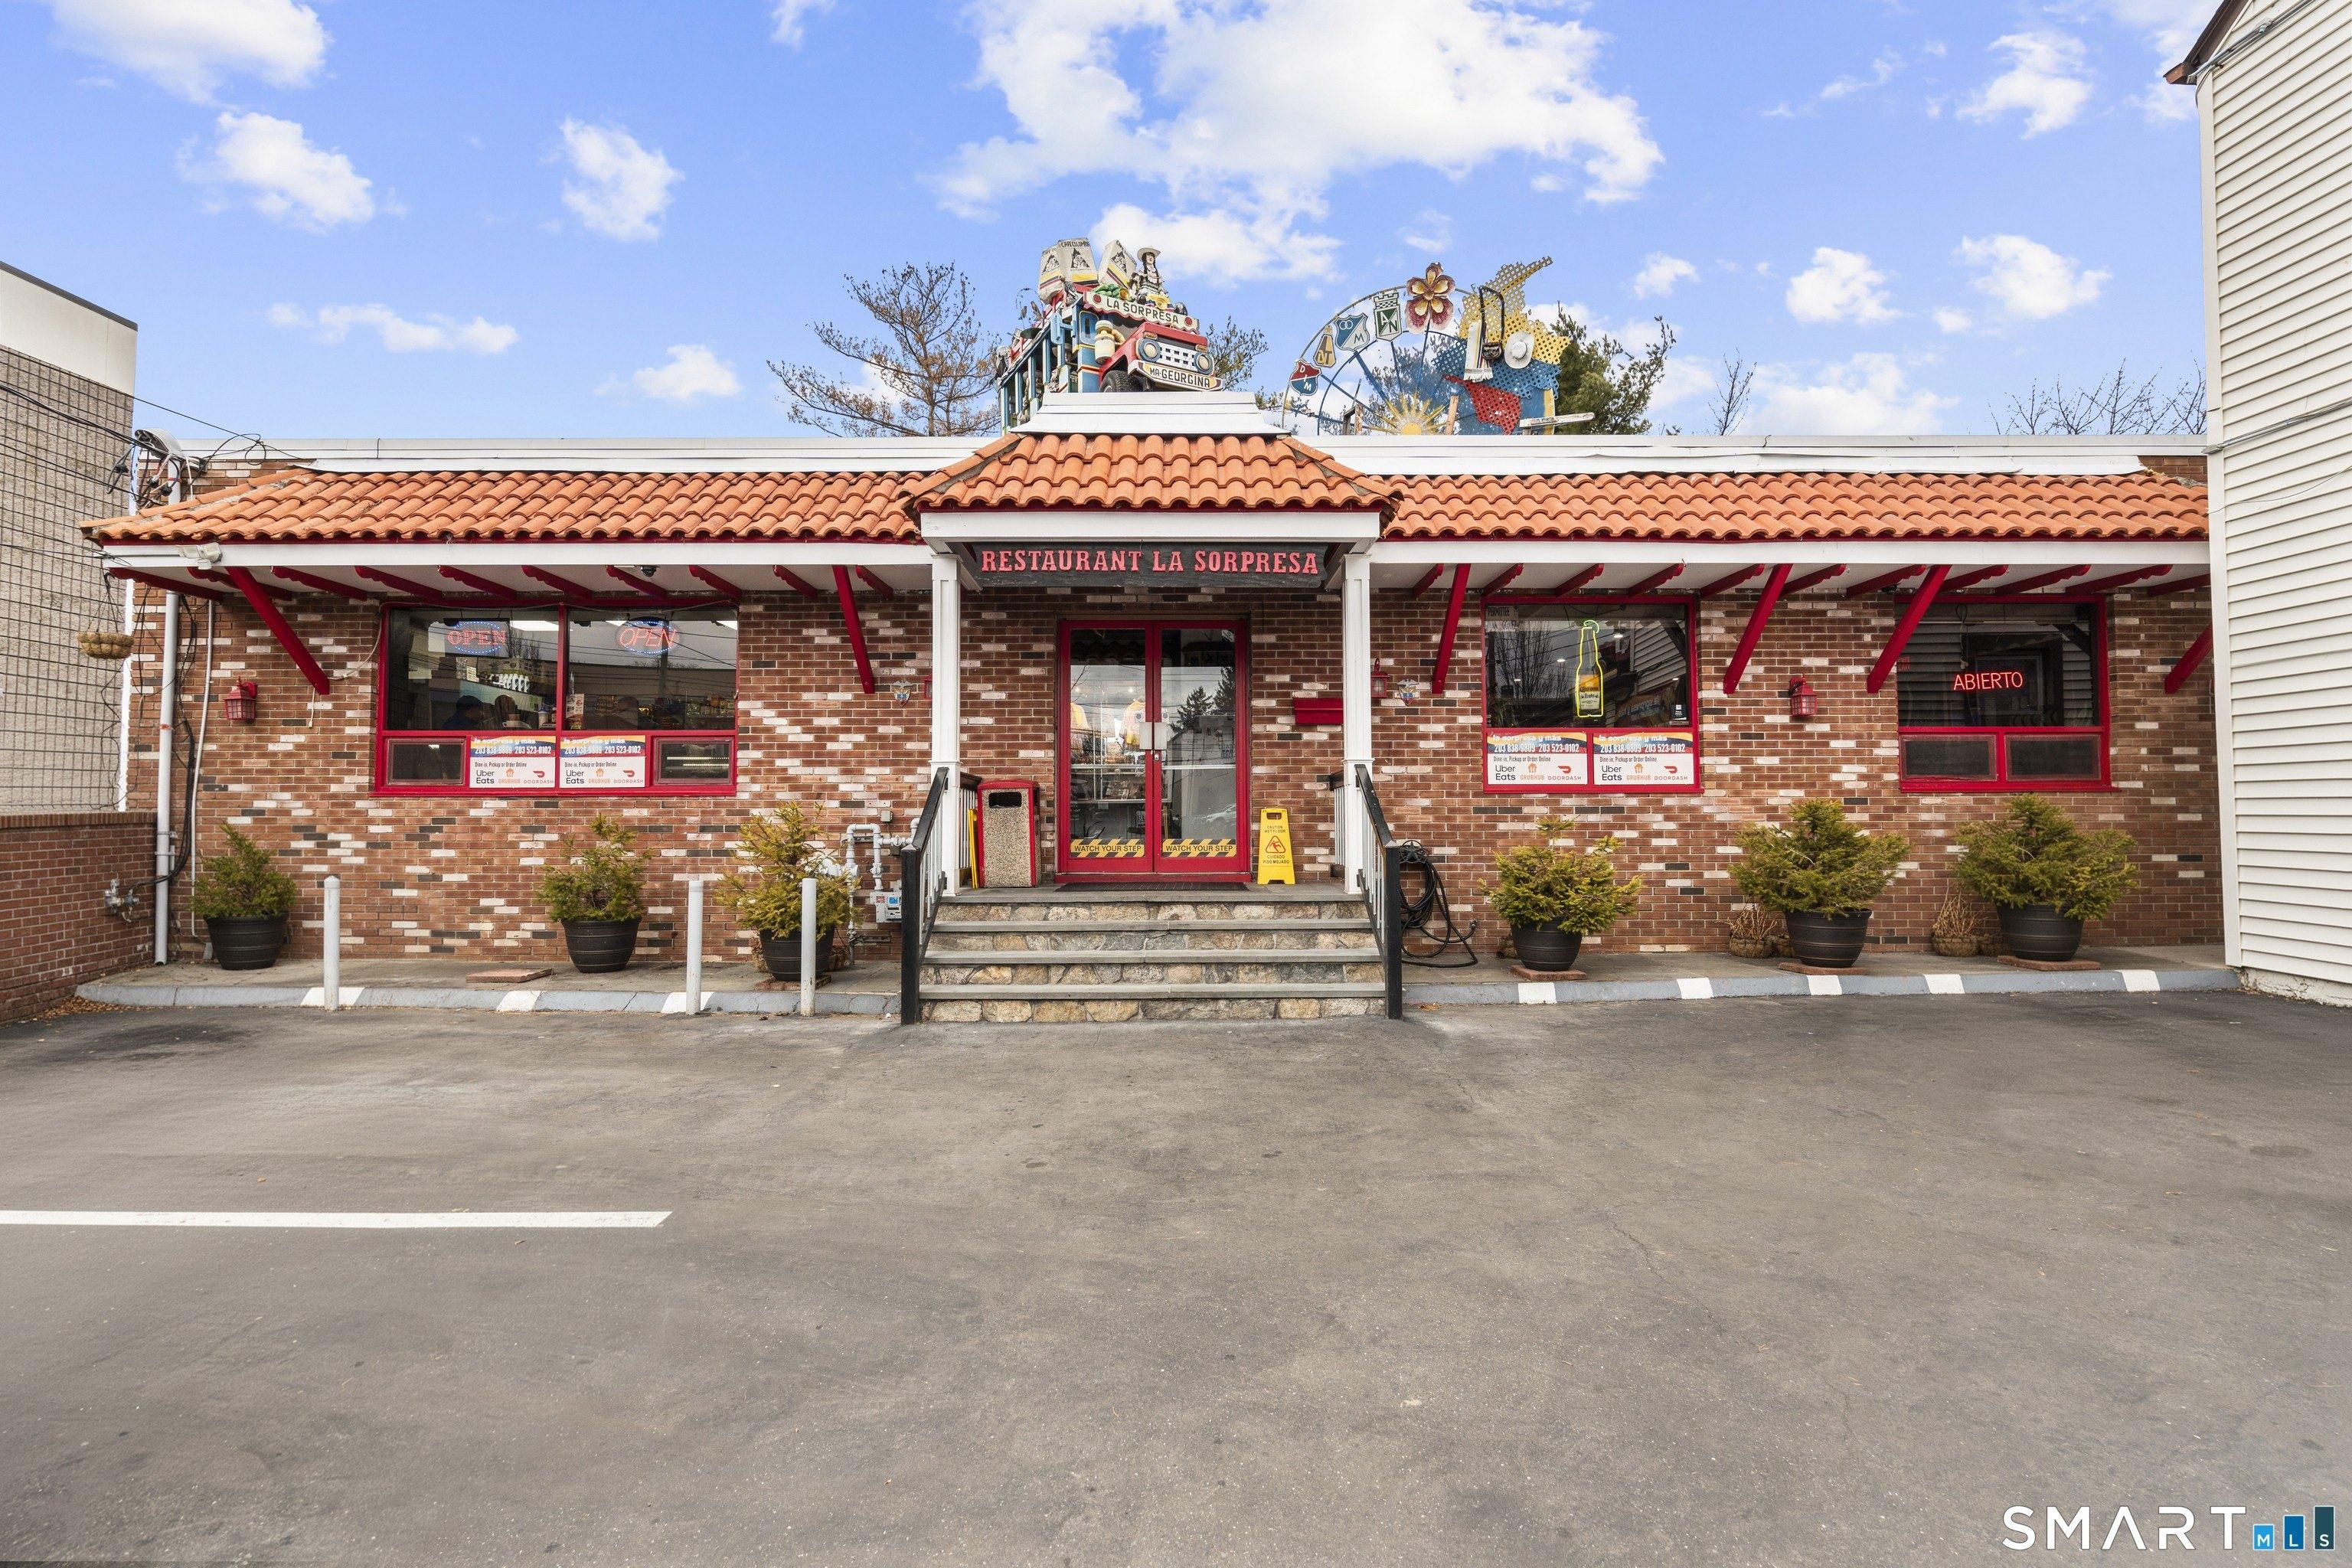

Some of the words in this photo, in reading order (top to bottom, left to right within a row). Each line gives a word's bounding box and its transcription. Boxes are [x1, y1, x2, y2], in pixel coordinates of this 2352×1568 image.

[1106, 298, 1120, 310] LA
[1122, 302, 1179, 325] SORPRESA
[981, 550, 1142, 573] RESTAURANT
[1152, 550, 1184, 573] LA
[1194, 550, 1318, 575] SORPRESA
[448, 630, 507, 645] OPEN
[619, 628, 677, 647] OPEN
[1954, 672, 2023, 691] ABIERTO
[514, 746, 525, 754] 203
[527, 746, 551, 754] 523-0102
[1494, 743, 1505, 753] 203
[1538, 743, 1550, 753] 203
[1551, 743, 1579, 753] 523-0102
[1600, 743, 1612, 753] 203
[1645, 743, 1657, 753] 203
[1658, 743, 1685, 753] 523-0102
